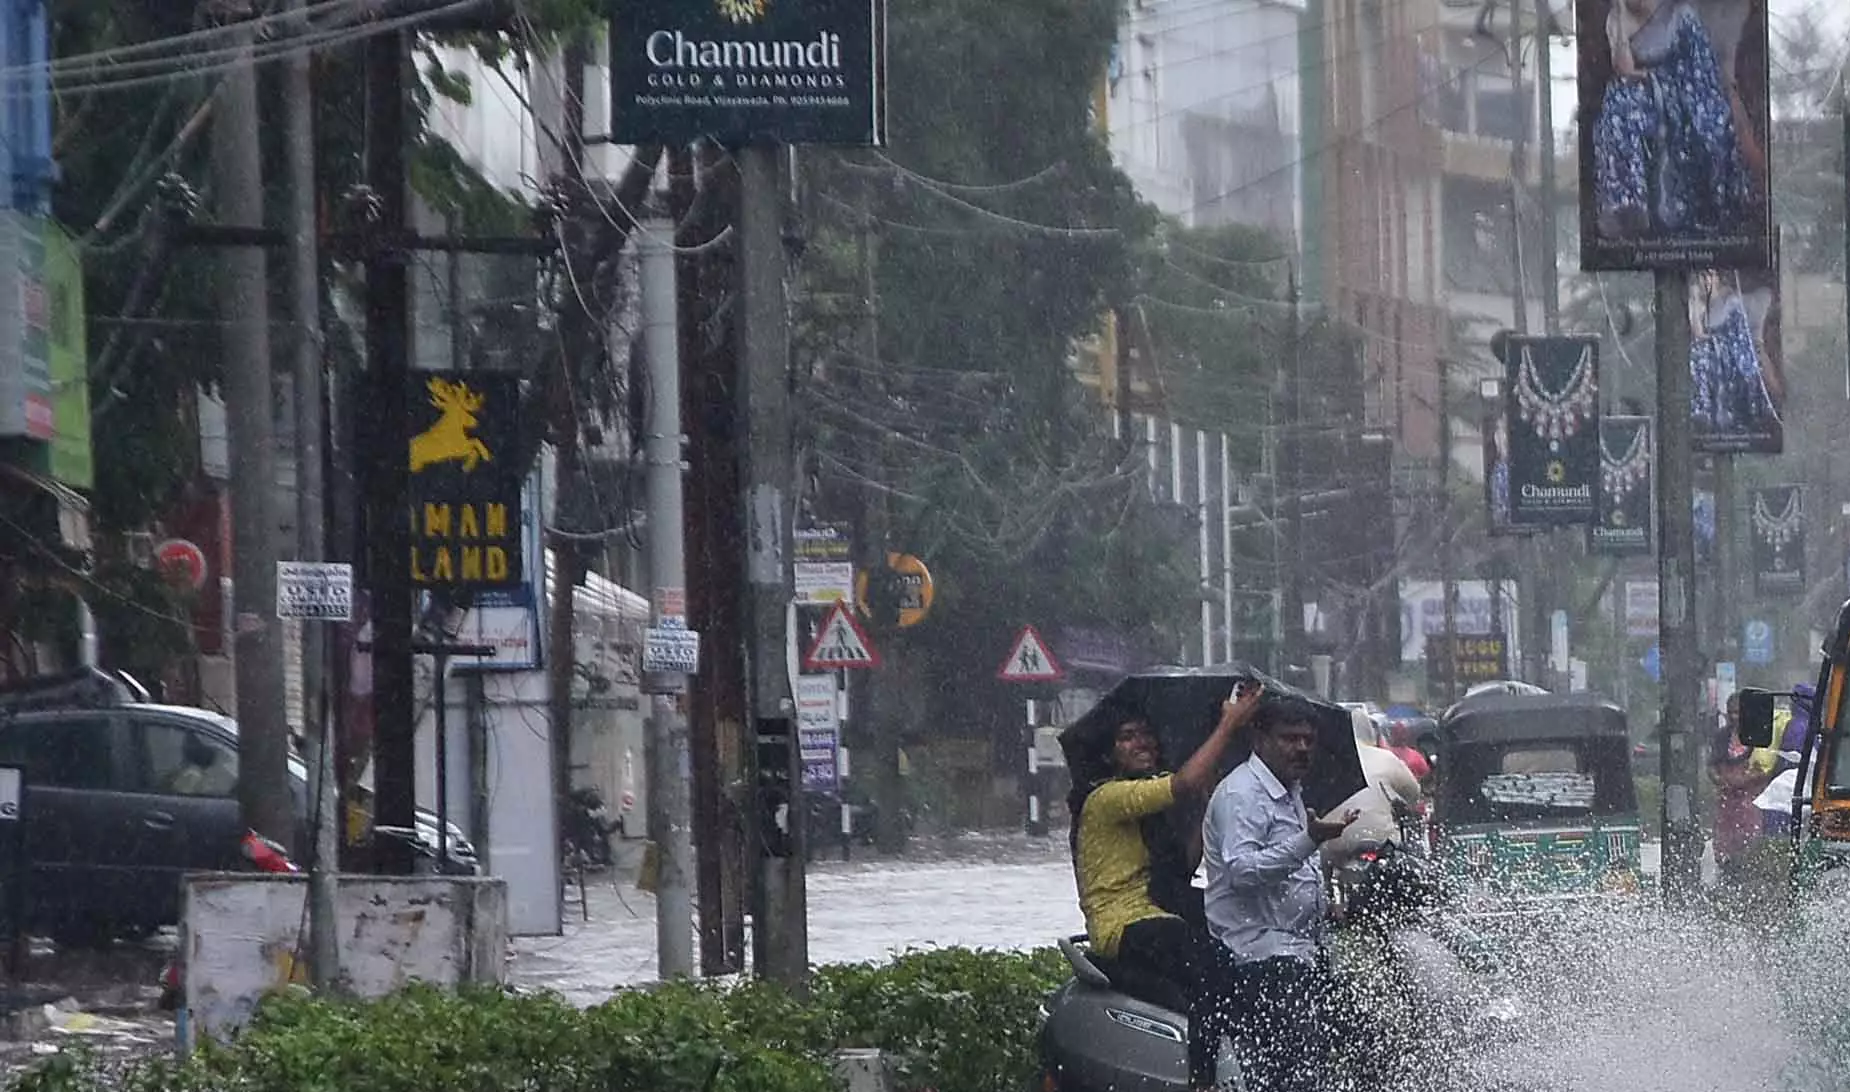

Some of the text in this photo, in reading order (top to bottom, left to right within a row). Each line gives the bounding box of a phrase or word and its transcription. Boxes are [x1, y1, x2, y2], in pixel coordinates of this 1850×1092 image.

[645, 30, 841, 68] Chamundi
[647, 73, 846, 88] GOLD & DIAMONDS
[1521, 483, 1591, 498] Chamundi
[1593, 527, 1644, 538] Chamundi
